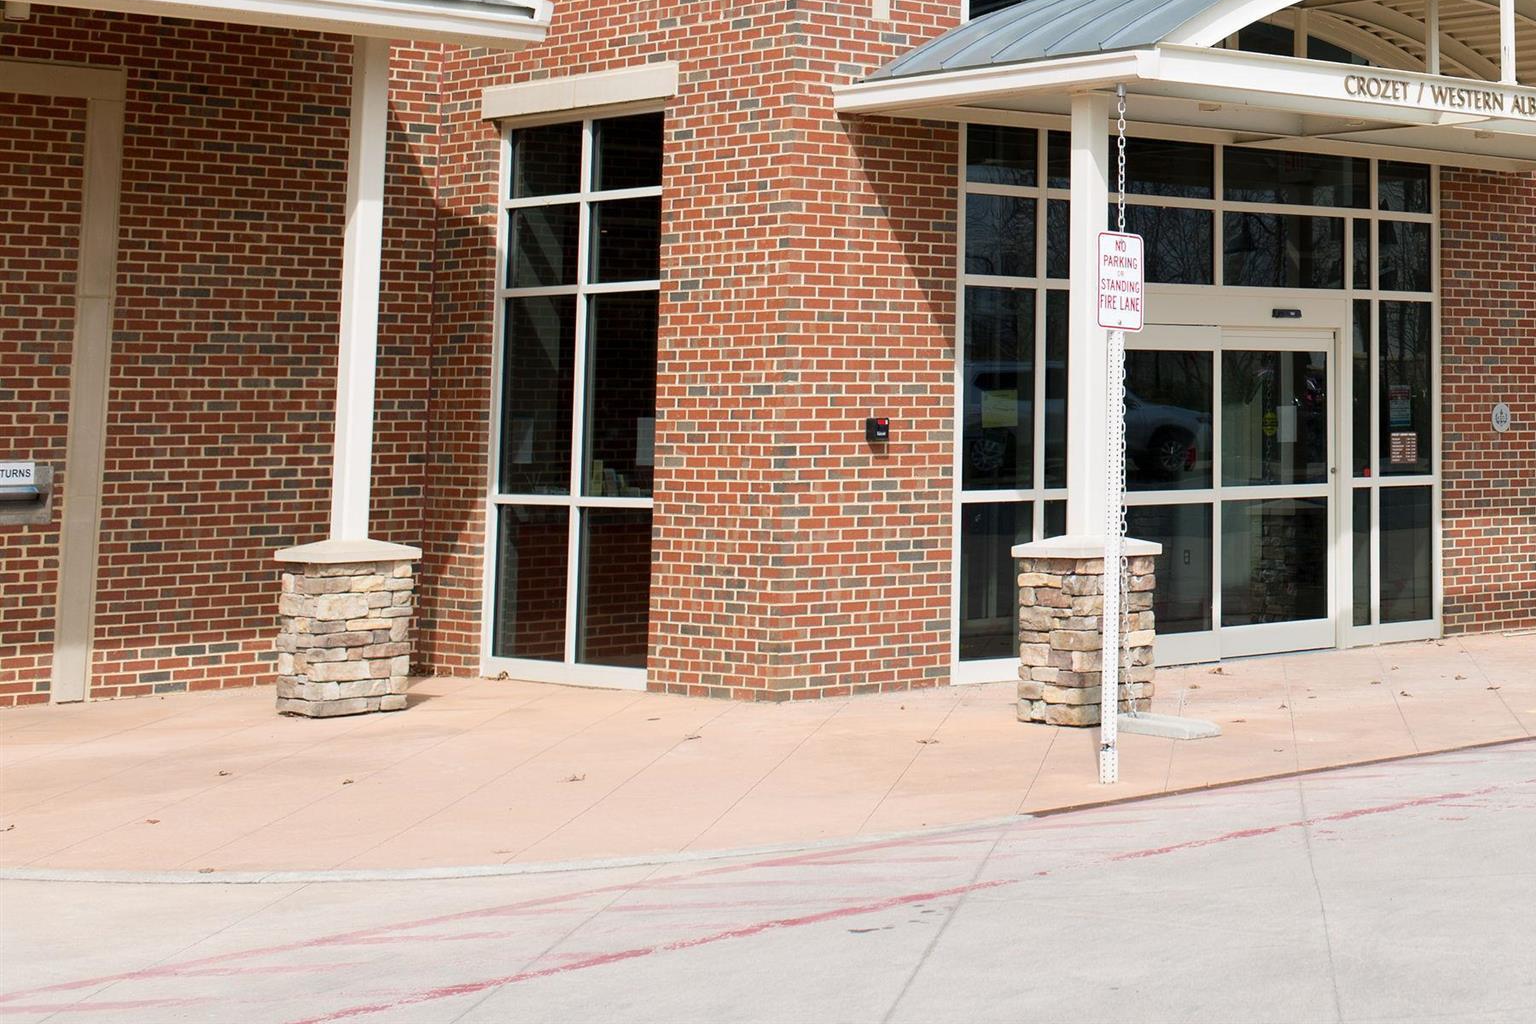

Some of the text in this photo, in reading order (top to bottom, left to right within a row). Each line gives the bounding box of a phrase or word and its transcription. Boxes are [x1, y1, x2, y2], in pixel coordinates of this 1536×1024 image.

[1344, 75, 1409, 100] CROZET
[1416, 82, 1424, 103] /
[1430, 84, 1504, 111] WESTERN
[1115, 240, 1127, 252] NO
[1103, 254, 1138, 270] PARKING
[1101, 278, 1140, 294] STANDING
[1100, 294, 1140, 313] FIRE LANE
[0, 469, 31, 478] TURNS
